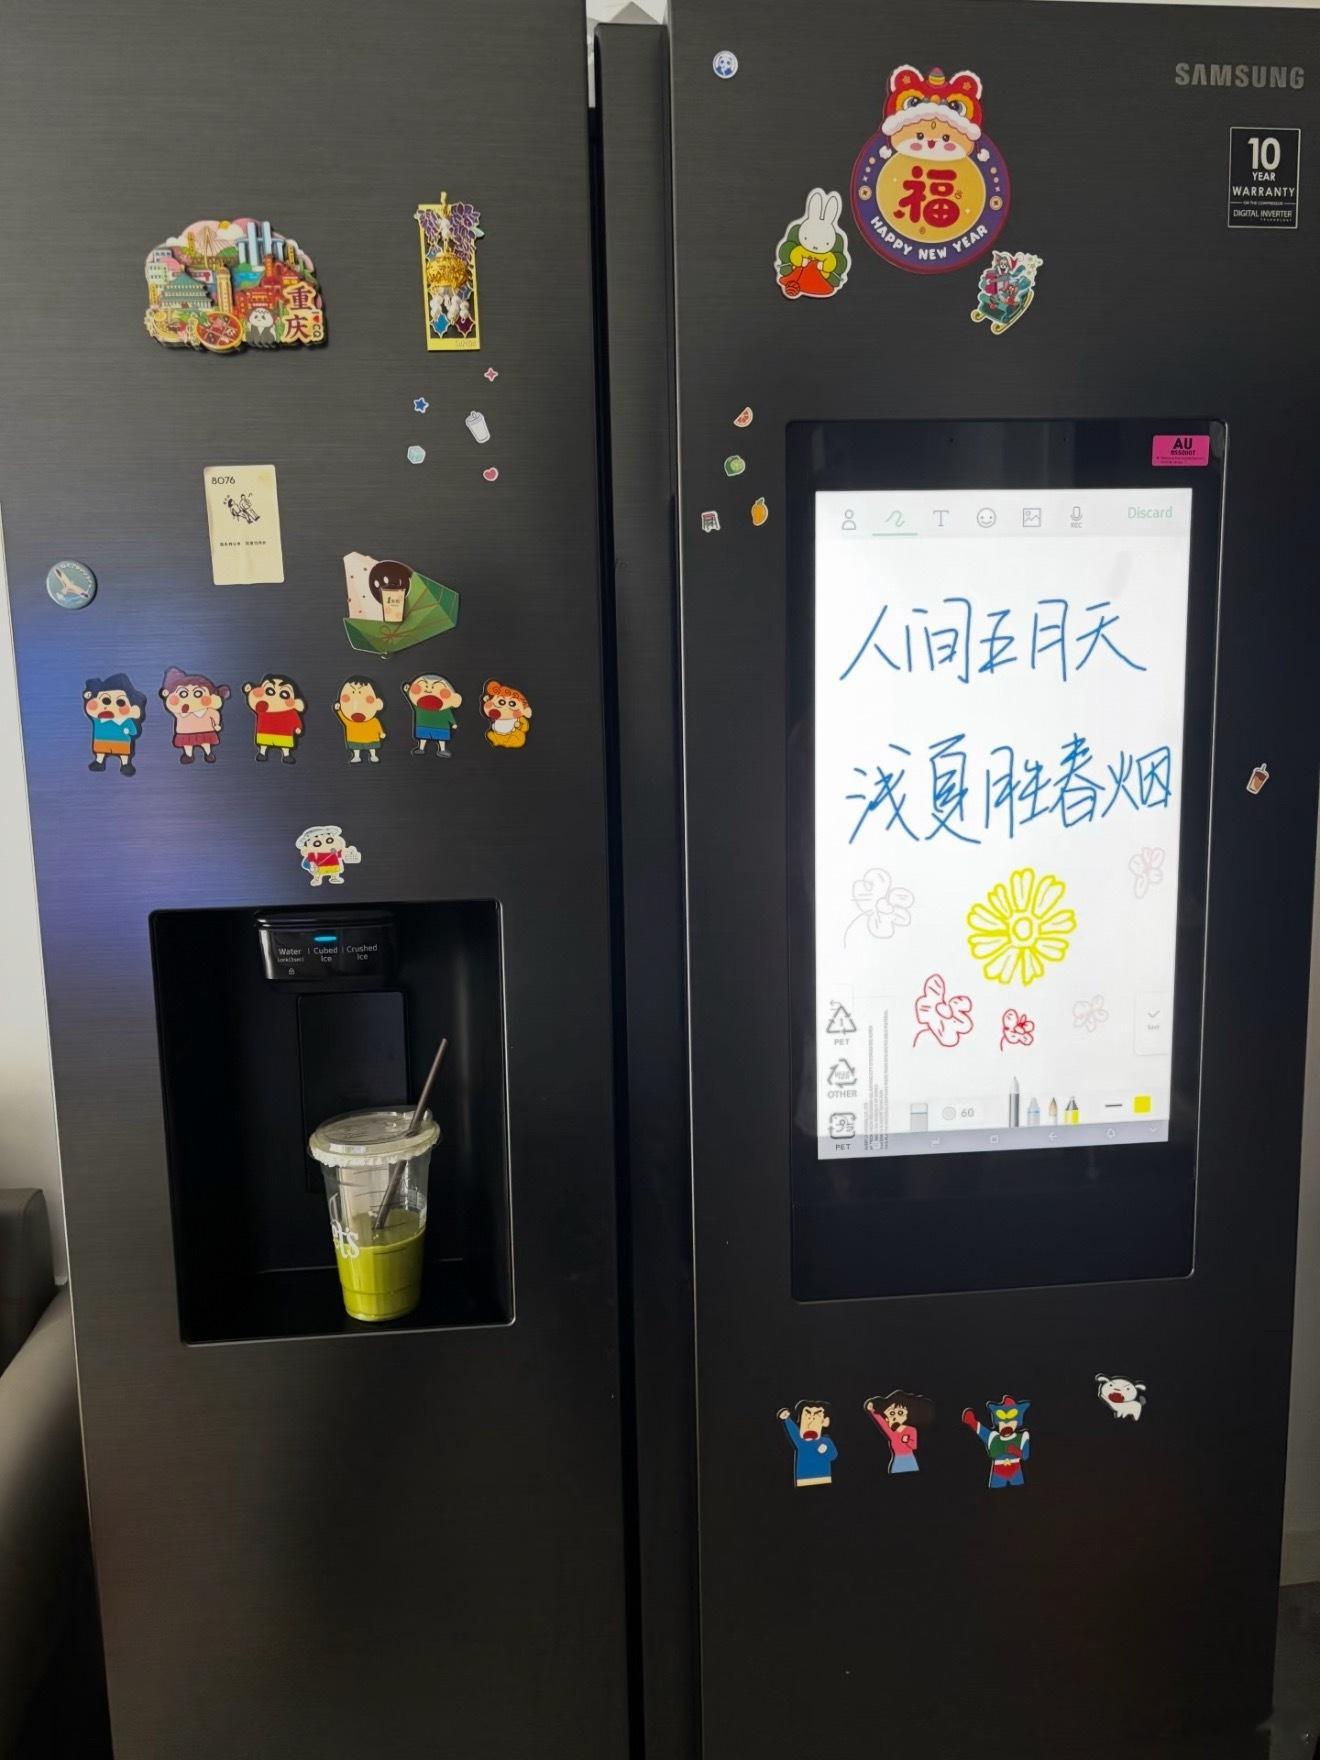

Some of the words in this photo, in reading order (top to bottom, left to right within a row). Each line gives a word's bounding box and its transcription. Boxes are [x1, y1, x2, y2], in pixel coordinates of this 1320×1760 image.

[1175, 62, 1305, 89] SAMSUNG
[1247, 137, 1281, 170] 10
[1252, 171, 1276, 182] YEAR
[893, 165, 960, 228] 福
[1232, 186, 1295, 197] WARRANTY
[1233, 209, 1259, 218] DIGITAL
[1260, 210, 1292, 218] INVERTER
[870, 216, 913, 256] HAPPY
[918, 247, 947, 260] NEW
[952, 224, 988, 253] YEAR
[285, 286, 312, 338] 重庆
[1173, 437, 1193, 450] AU
[211, 476, 236, 485] 8076
[1127, 506, 1174, 519] Discard
[278, 947, 302, 956] Water
[313, 946, 338, 955] Cubed
[346, 944, 378, 953] Crushed
[834, 1038, 851, 1046] PET
[828, 1089, 858, 1099] OTHER
[961, 1108, 974, 1118] 60
[835, 1143, 851, 1151] PET
